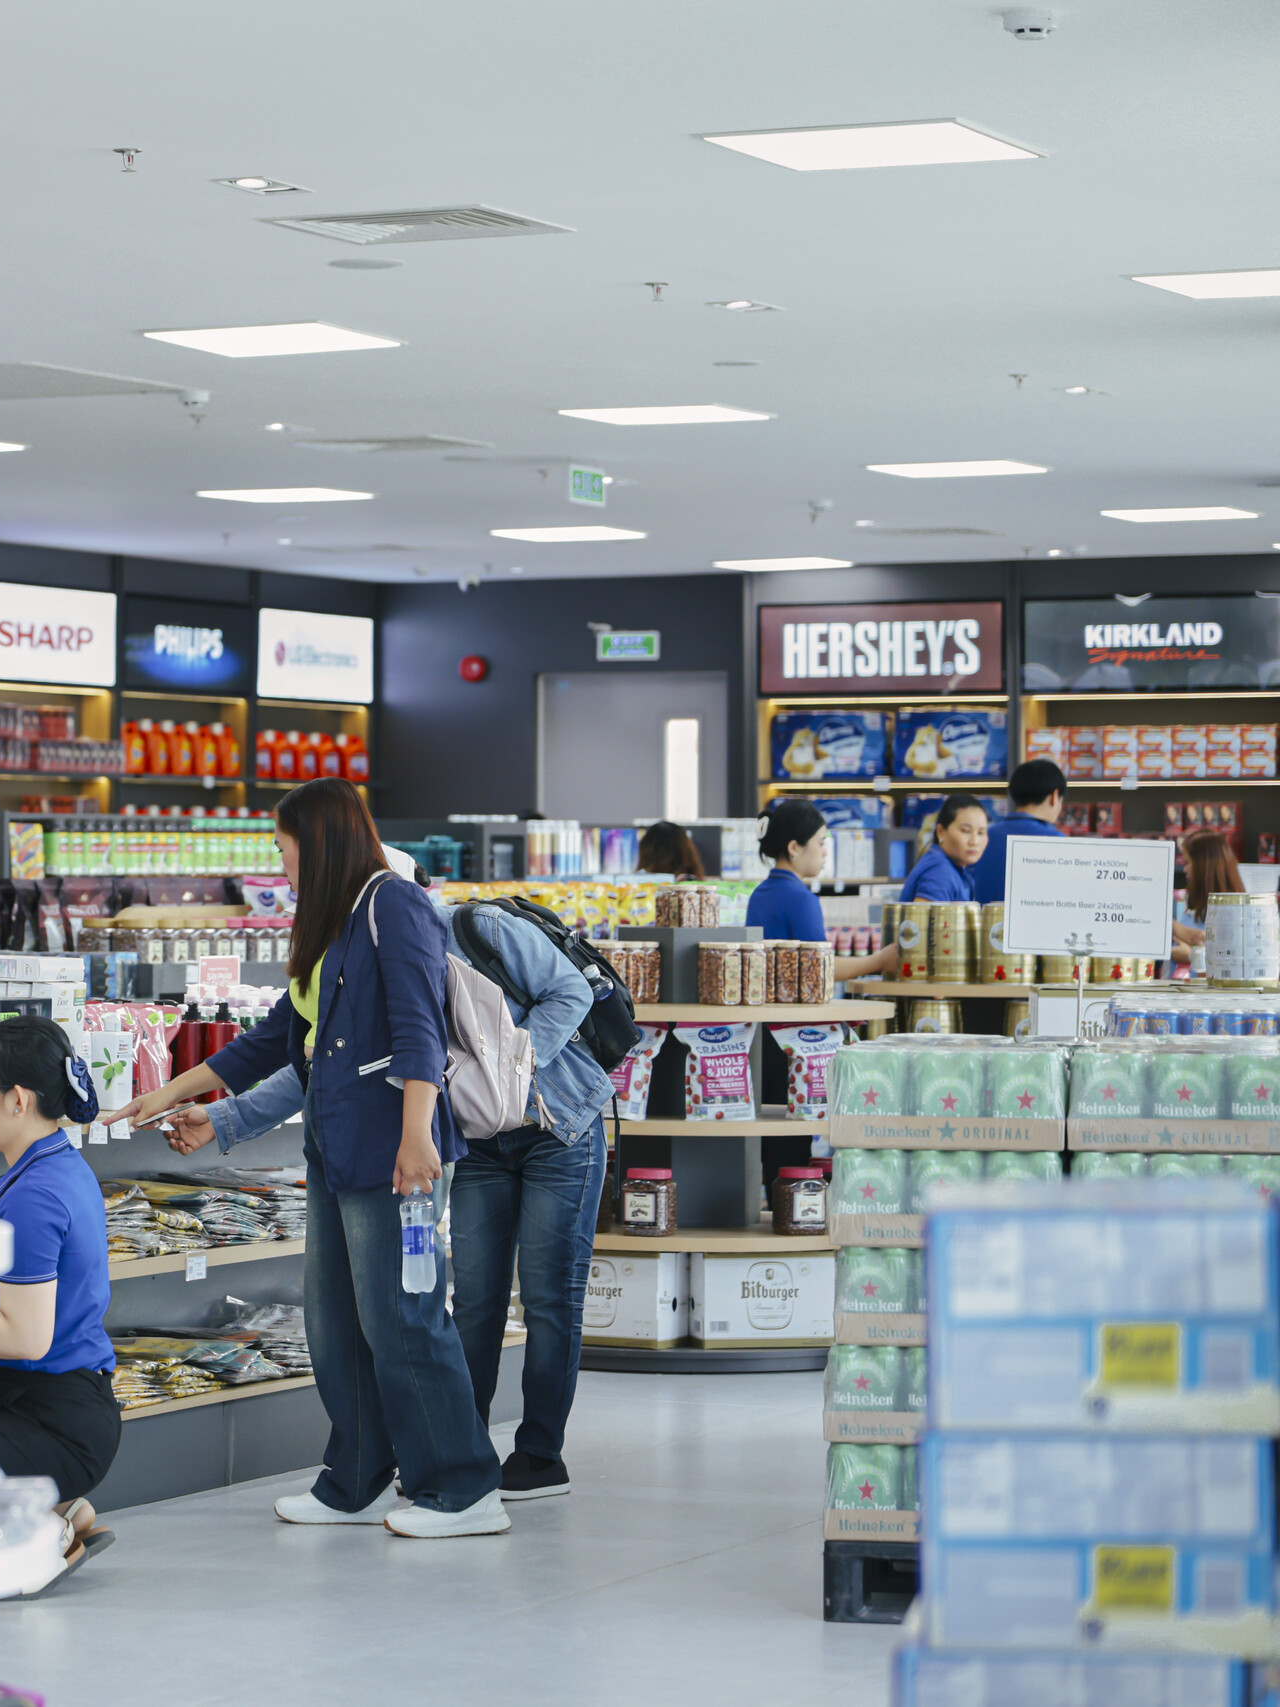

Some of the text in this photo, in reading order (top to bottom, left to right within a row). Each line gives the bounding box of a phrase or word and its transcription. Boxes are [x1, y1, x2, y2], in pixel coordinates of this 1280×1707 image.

[154, 624, 223, 659] PHILIPS
[1084, 622, 1223, 648] KIRKLAND
[782, 618, 980, 679] HERSHEY'S
[1087, 647, 1221, 667] Signature
[1022, 856, 1128, 868] Heineken Can Beer 24x500ml
[1096, 870, 1126, 881] 27.00
[1020, 899, 1132, 911] Heineken Bottle Beer 24x250ml
[1094, 912, 1124, 923] 23.00
[696, 1041, 747, 1054] CRAISINS
[705, 1056, 745, 1067] WHOLE
[706, 1066, 744, 1078] & JUICY
[706, 1081, 745, 1089] CRANBERRIES
[1078, 1102, 1140, 1115] Heineken
[1154, 1103, 1217, 1117] Heineken
[864, 1124, 1031, 1141] Heineken ORIGINAL
[1082, 1130, 1252, 1146] Heineken ORIGINAL
[838, 1201, 901, 1214] Heineken
[740, 1281, 799, 1301] Bitburger
[833, 1391, 894, 1406] Heineken
[838, 1423, 905, 1437] Heineken
[839, 1519, 905, 1533] Heineken
